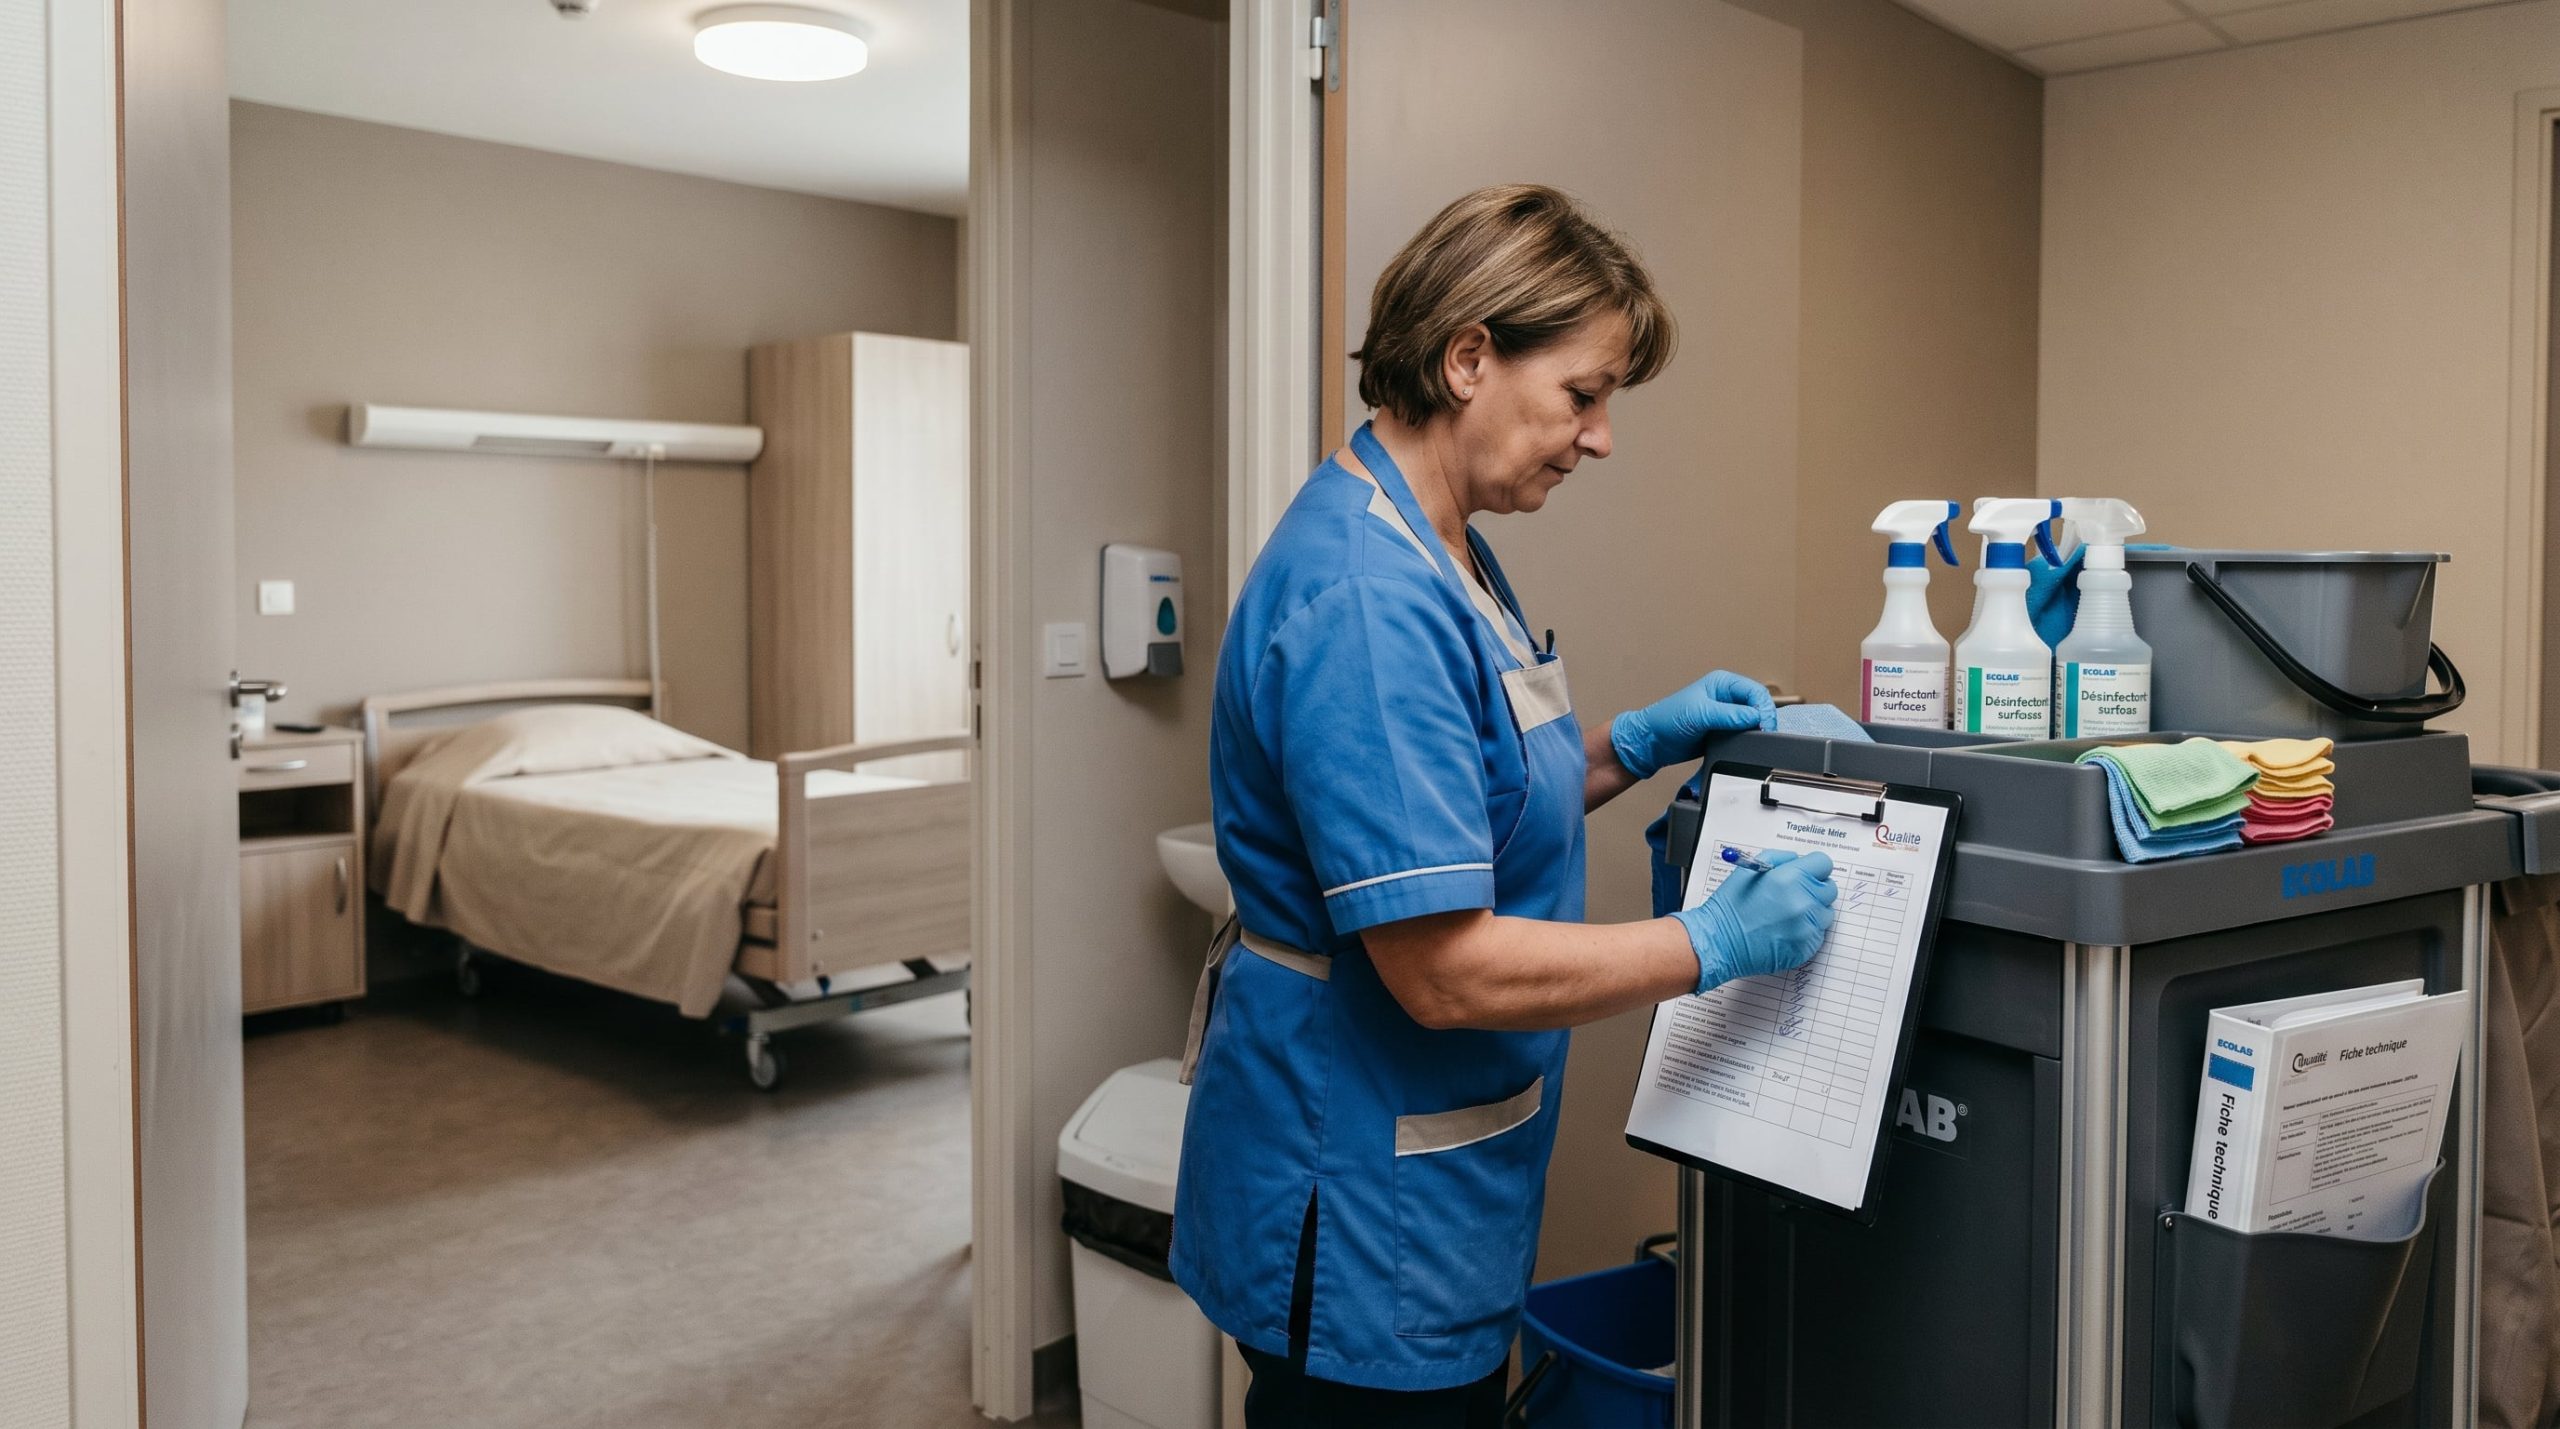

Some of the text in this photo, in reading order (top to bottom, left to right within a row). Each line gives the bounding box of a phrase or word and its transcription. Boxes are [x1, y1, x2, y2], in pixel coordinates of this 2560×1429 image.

[1883, 701, 1927, 712] surfaces
[2281, 852, 2376, 899] ECOLAB
[2339, 1038, 2408, 1062] Fiche technique
[2206, 1092, 2236, 1221] Fiche technique
